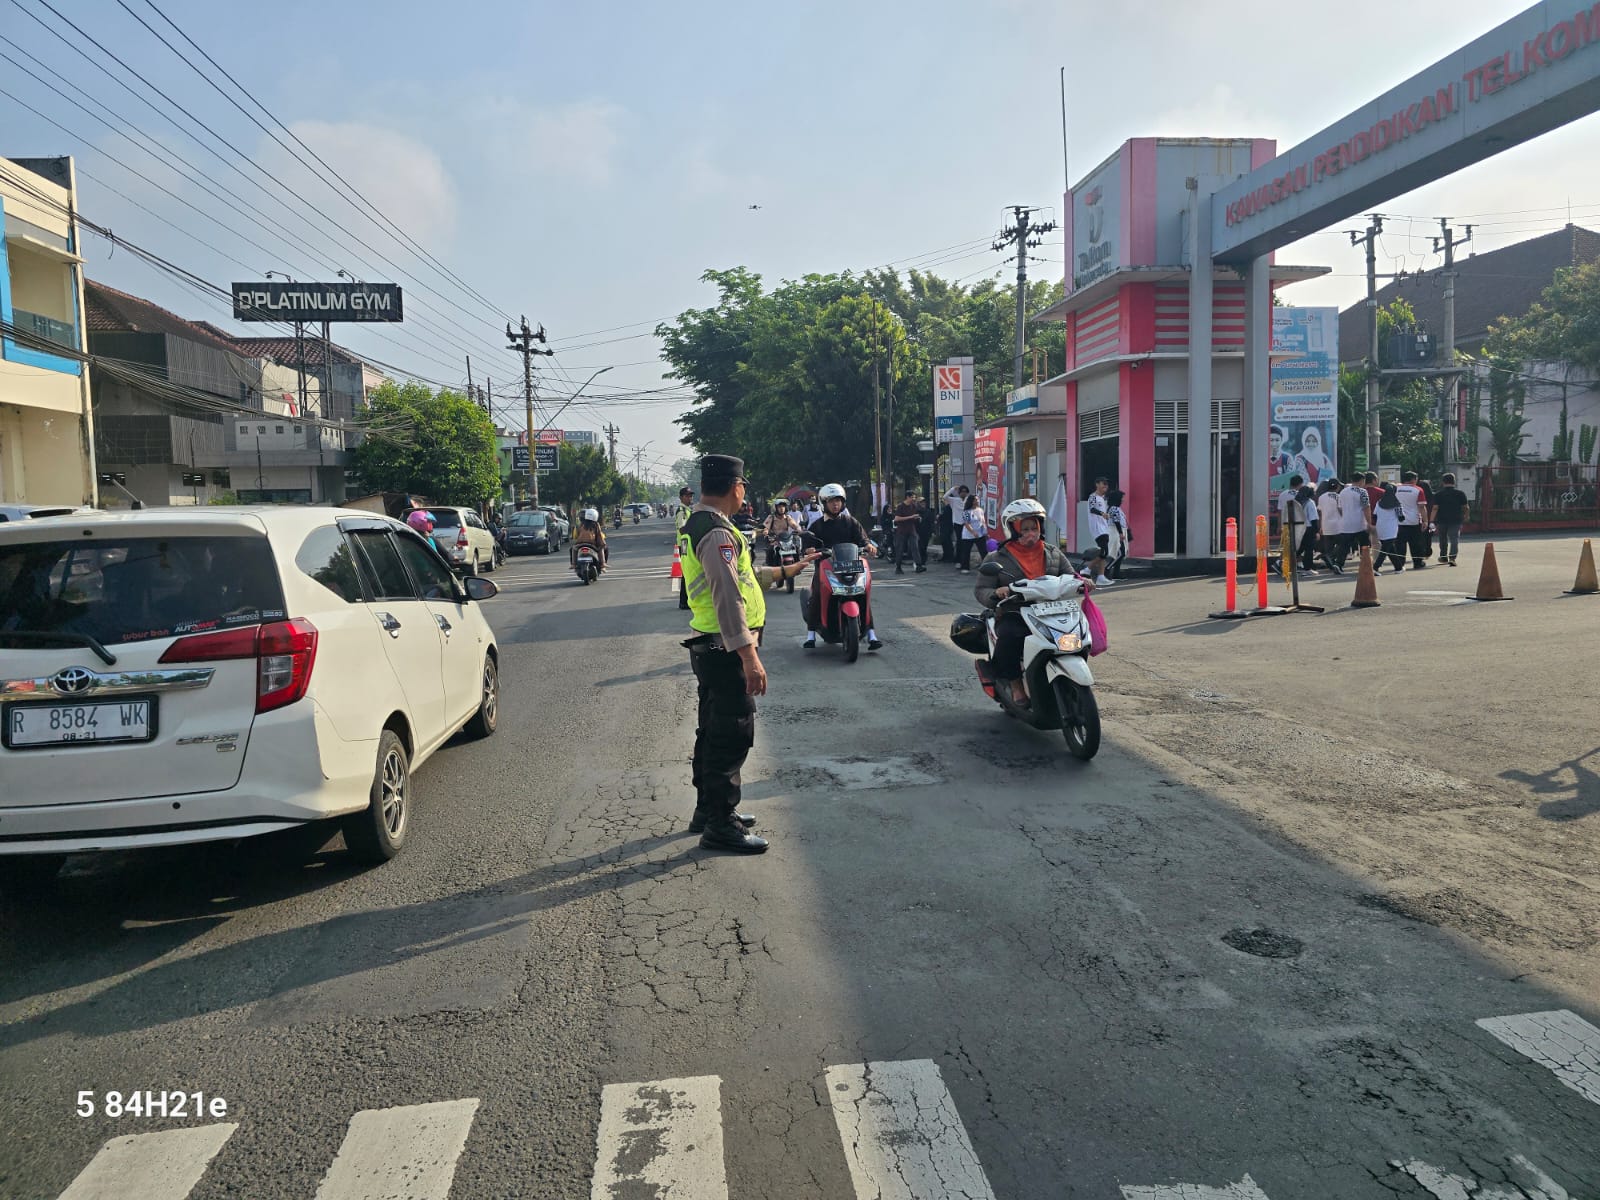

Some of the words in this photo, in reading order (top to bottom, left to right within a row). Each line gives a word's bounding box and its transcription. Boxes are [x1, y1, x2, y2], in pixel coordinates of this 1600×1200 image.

[1225, 165, 1310, 228] KAWASAN
[1312, 82, 1456, 184] PENDIDIKAN
[1462, 1, 1600, 104] TELKOM
[238, 291, 347, 310] D'PLATINUM
[350, 292, 391, 310] GYM
[940, 390, 960, 401] BNI
[13, 711, 25, 733] R
[49, 706, 99, 730] 8584
[120, 704, 145, 727] WK
